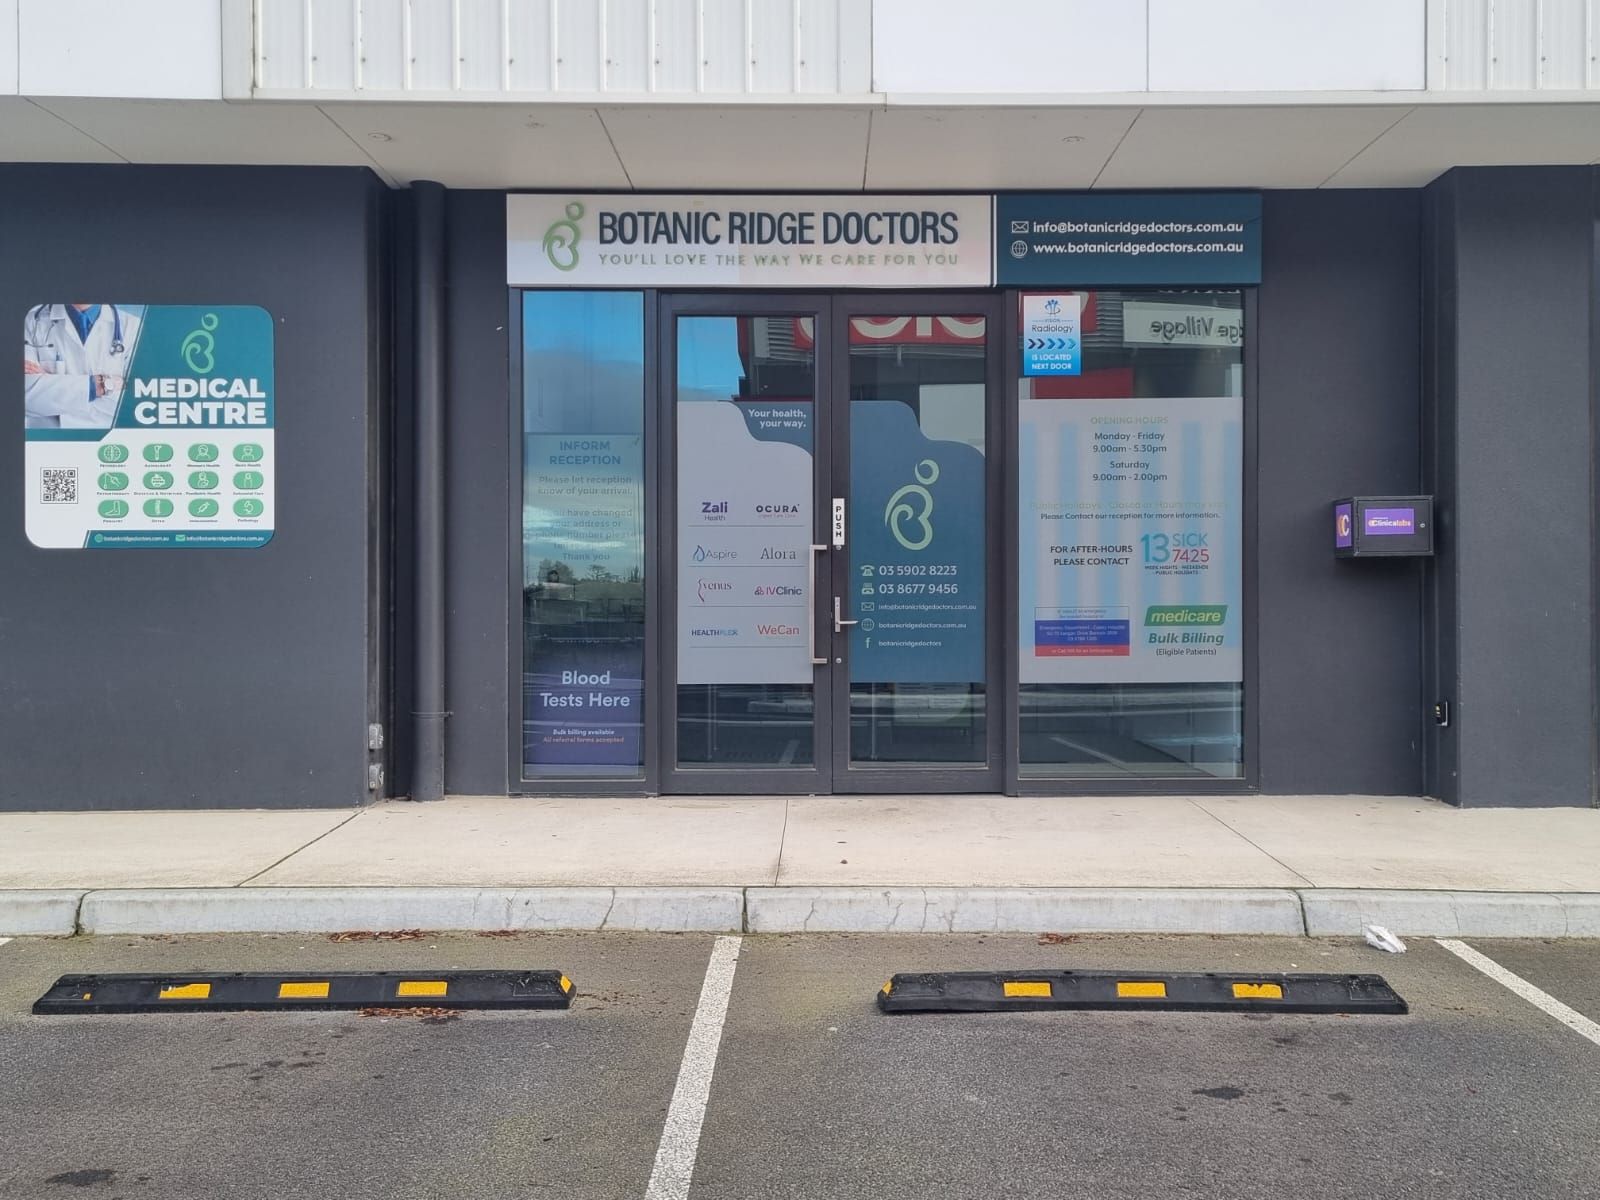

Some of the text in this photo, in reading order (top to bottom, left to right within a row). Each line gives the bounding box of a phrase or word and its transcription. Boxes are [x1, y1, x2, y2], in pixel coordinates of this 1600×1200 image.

[599, 211, 959, 245] BOTANIC RIDGE DOCTORS
[1033, 221, 1244, 235] info@botanicridgedoctors.com.au
[1033, 241, 1244, 255] www.botanicridgedoctors.com.au
[599, 254, 958, 267] YOU'LL LOVE THE WAY WE CARE FOR YOU
[1032, 324, 1074, 334] Radiology
[1032, 353, 1072, 361] IS LOCATED
[134, 378, 266, 398] MEDICAL
[134, 402, 267, 425] CENTRE
[748, 409, 807, 419] Your health,
[760, 420, 807, 430] your way.
[1090, 416, 1169, 425] OPENING HOURS
[1094, 432, 1131, 441] Monday
[1137, 431, 1165, 441] Friday
[560, 440, 611, 451] INFORM
[1092, 445, 1127, 453] 9.00am
[1134, 444, 1167, 454] 5.30pm
[549, 455, 621, 465] RECEPTION
[1109, 460, 1150, 470] Saturday
[1092, 473, 1127, 481] 9.00am
[1134, 473, 1168, 483] 2.00pm
[701, 501, 728, 514] Zali
[756, 504, 799, 513] OCURA
[704, 514, 726, 522] Health
[1109, 512, 1143, 521] reception
[1050, 545, 1133, 554] FOR AFTER-HOURS
[1140, 532, 1209, 563] 13 SICK
[706, 549, 738, 561] Aspire
[760, 547, 797, 561] Alora
[1172, 548, 1210, 563] 7425
[1053, 557, 1130, 566] PLEASE CONTACT
[878, 565, 958, 576] 03 5902 8223
[765, 586, 803, 596] IVClinic
[878, 583, 959, 594] 03 8677 9456
[1151, 609, 1222, 624] medicare
[691, 629, 739, 637] HEALTHPLEX
[757, 624, 800, 636] WeCan
[1148, 632, 1225, 646] Bulk Billing
[1155, 647, 1217, 657] (Eligible Patients)
[561, 670, 611, 685] Blood
[539, 692, 631, 708] Tests Here
[567, 729, 587, 737] billing
